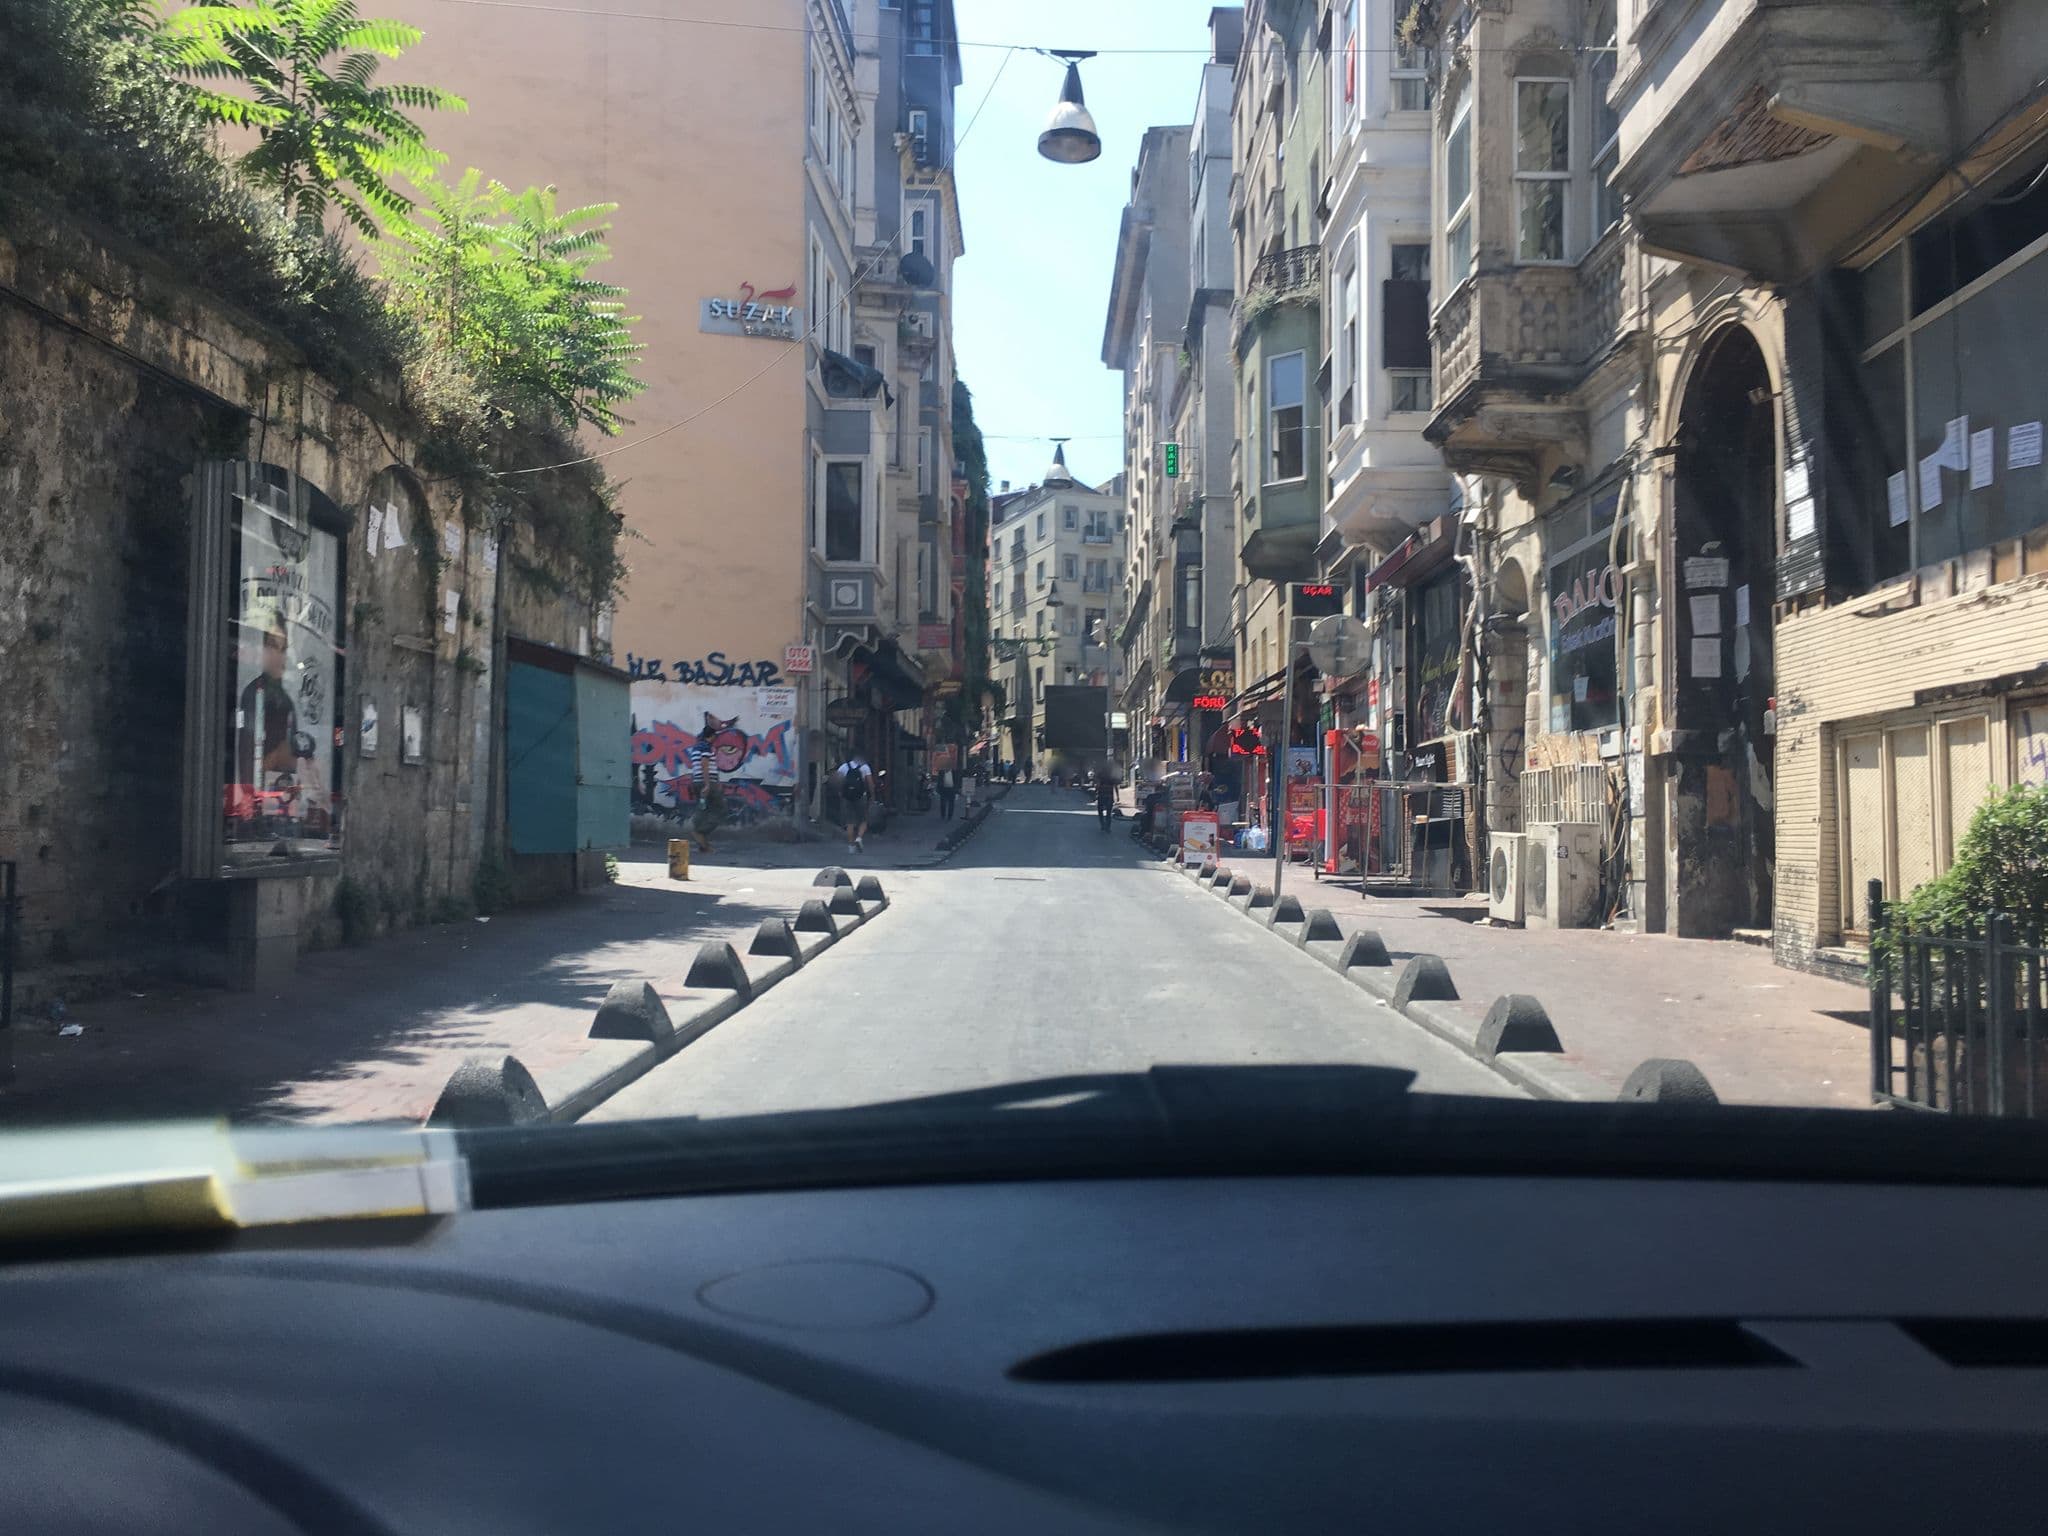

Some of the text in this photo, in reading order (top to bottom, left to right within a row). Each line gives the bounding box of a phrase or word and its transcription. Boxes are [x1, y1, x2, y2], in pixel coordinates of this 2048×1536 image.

[710, 298, 793, 325] SUZAK
[788, 647, 809, 658] OTO
[785, 659, 811, 669] PARK
